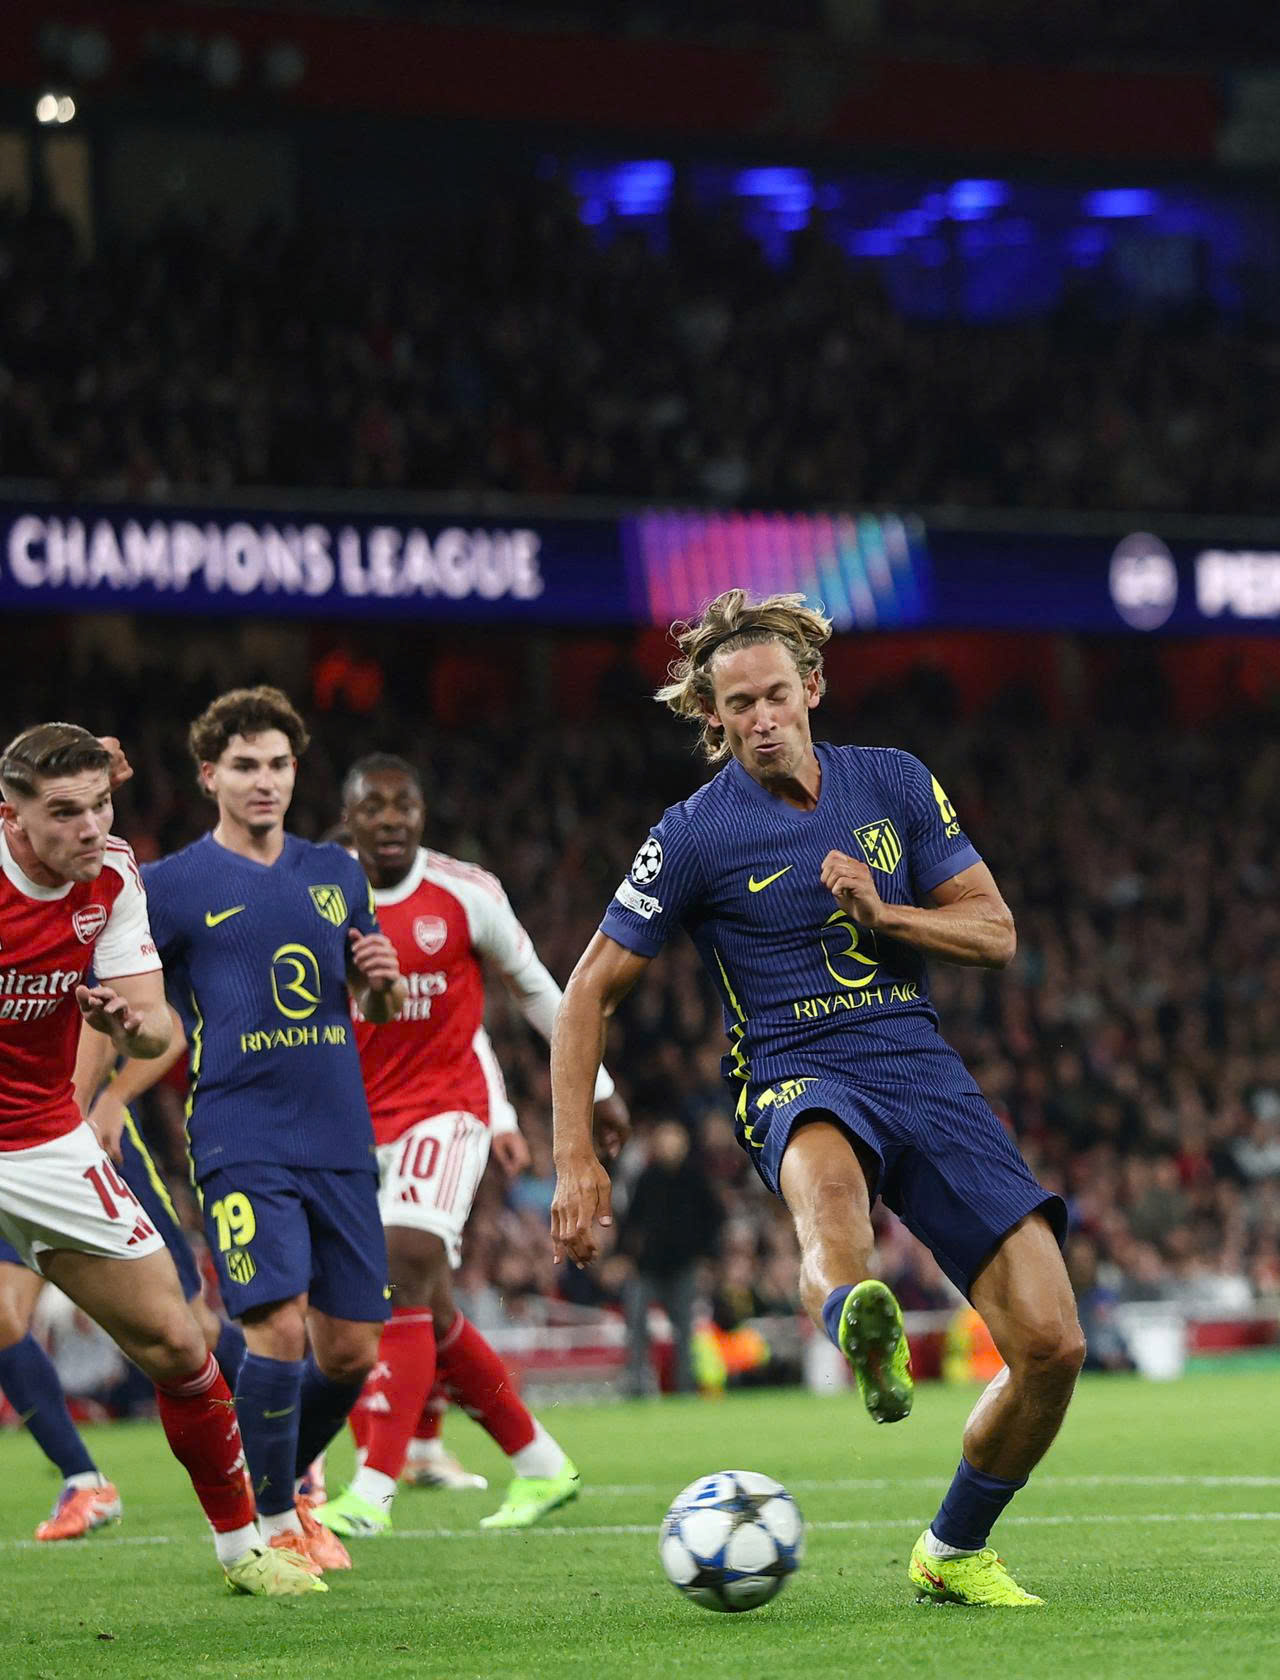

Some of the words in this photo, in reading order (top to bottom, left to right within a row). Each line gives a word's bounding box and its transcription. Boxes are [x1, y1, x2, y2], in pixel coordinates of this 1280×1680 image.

[8, 515, 335, 596] CHAMPIONS
[338, 525, 544, 599] LEAGUE
[794, 987, 884, 1020] RIYADH
[889, 981, 920, 1003] AIR
[240, 1024, 318, 1054] RIYADH
[322, 1024, 346, 1046] AIR
[399, 1135, 441, 1179] 10
[211, 1191, 256, 1252] 19
